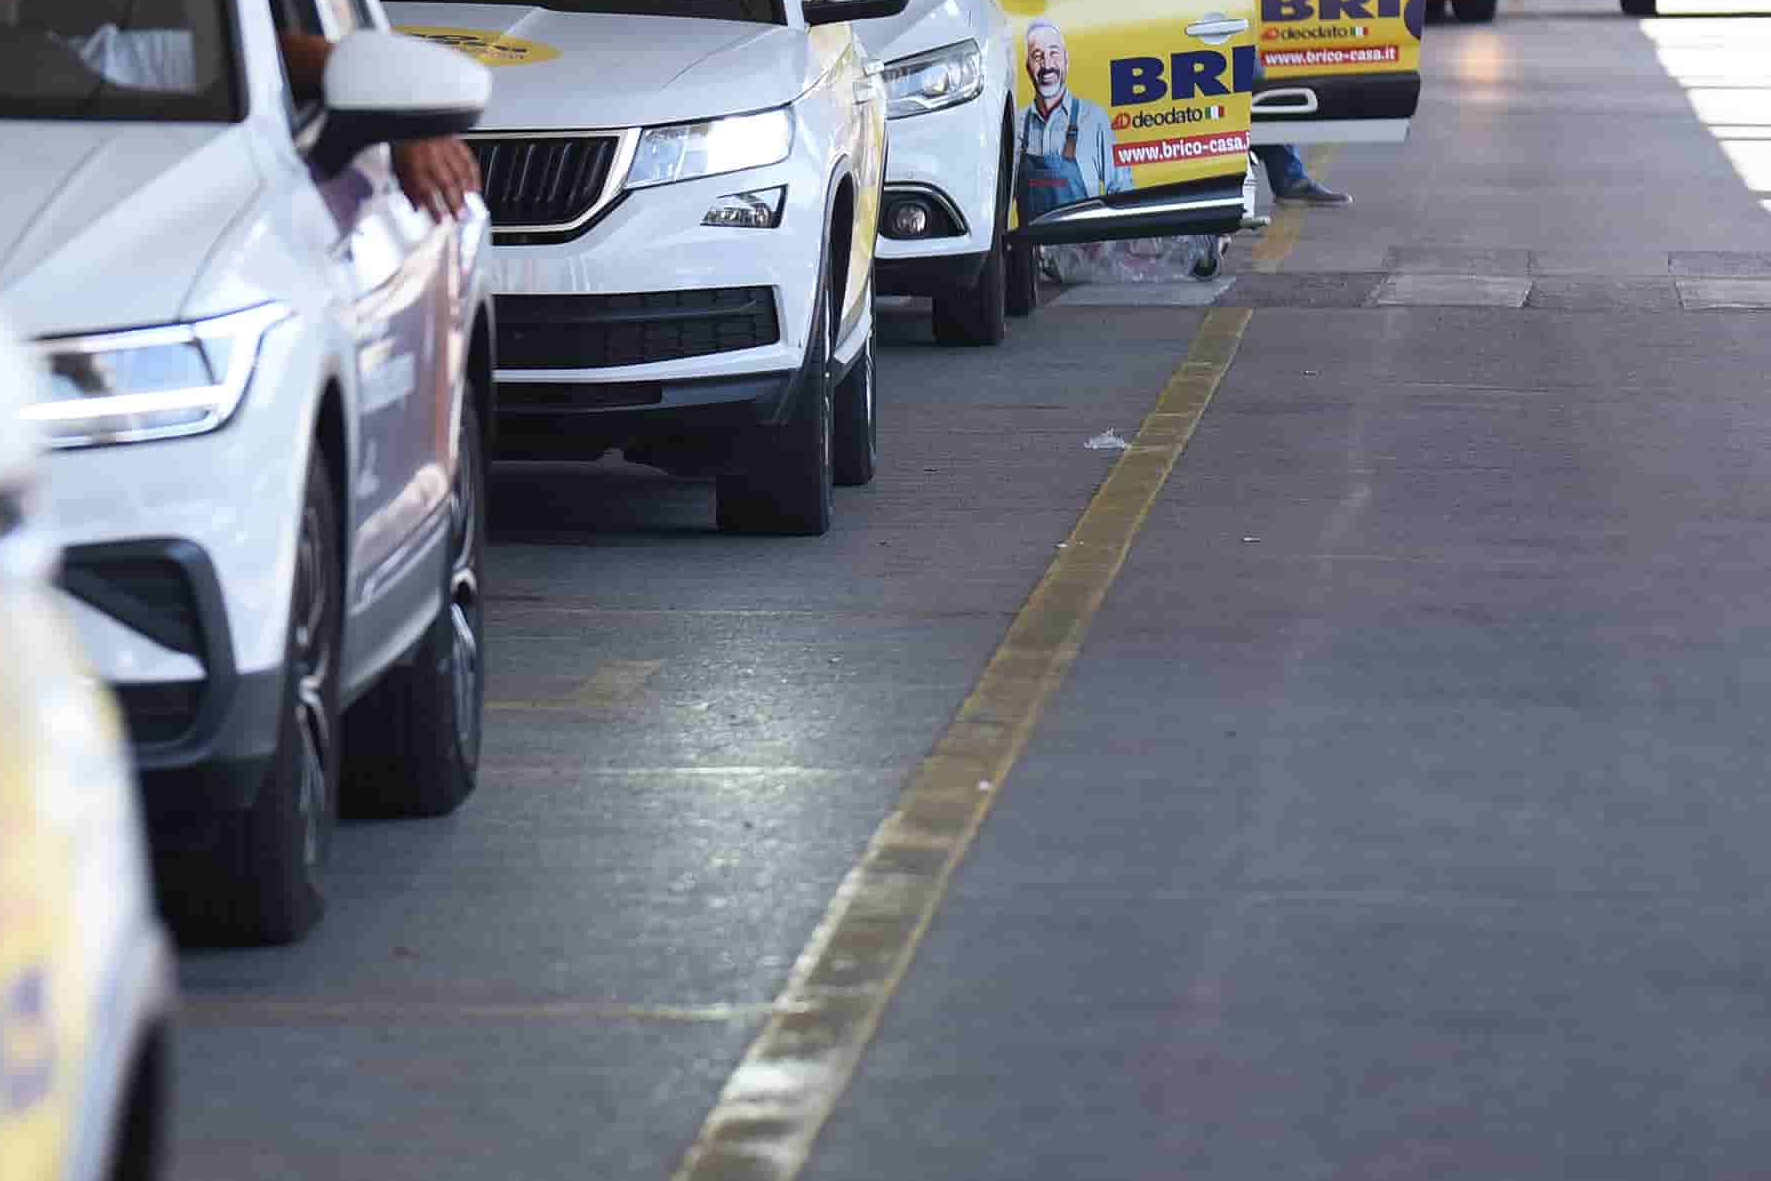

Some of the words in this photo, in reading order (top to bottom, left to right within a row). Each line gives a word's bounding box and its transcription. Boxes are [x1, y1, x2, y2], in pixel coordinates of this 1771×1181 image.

[1282, 27, 1348, 41] deodato
[1266, 48, 1396, 66] www.brico-casa.it
[1132, 105, 1203, 130] deodato
